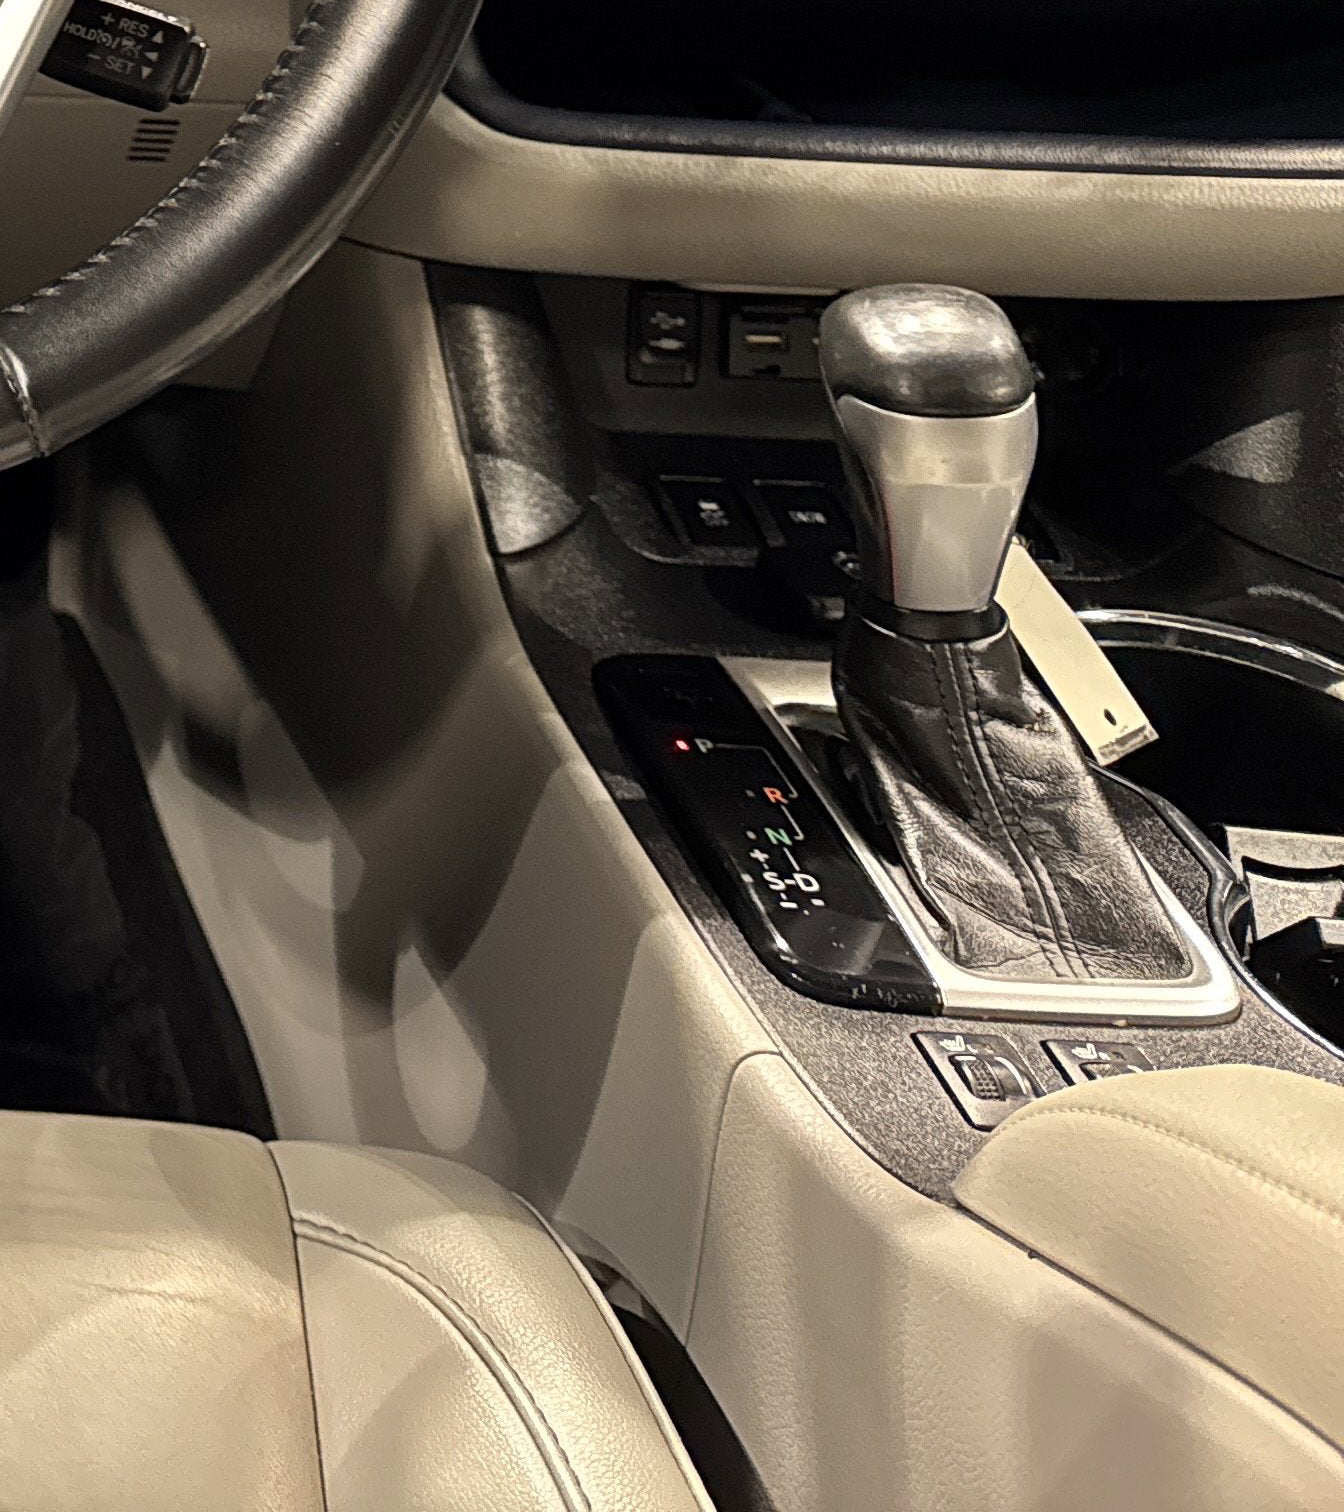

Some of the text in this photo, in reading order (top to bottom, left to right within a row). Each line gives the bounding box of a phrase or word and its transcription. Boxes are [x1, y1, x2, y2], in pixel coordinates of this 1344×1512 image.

[63, 21, 97, 41] HOLD
[118, 17, 150, 39] RES
[105, 57, 137, 75] SET
[695, 738, 714, 754] P
[762, 786, 789, 805] R
[764, 827, 793, 846] N
[762, 871, 821, 892] S D
